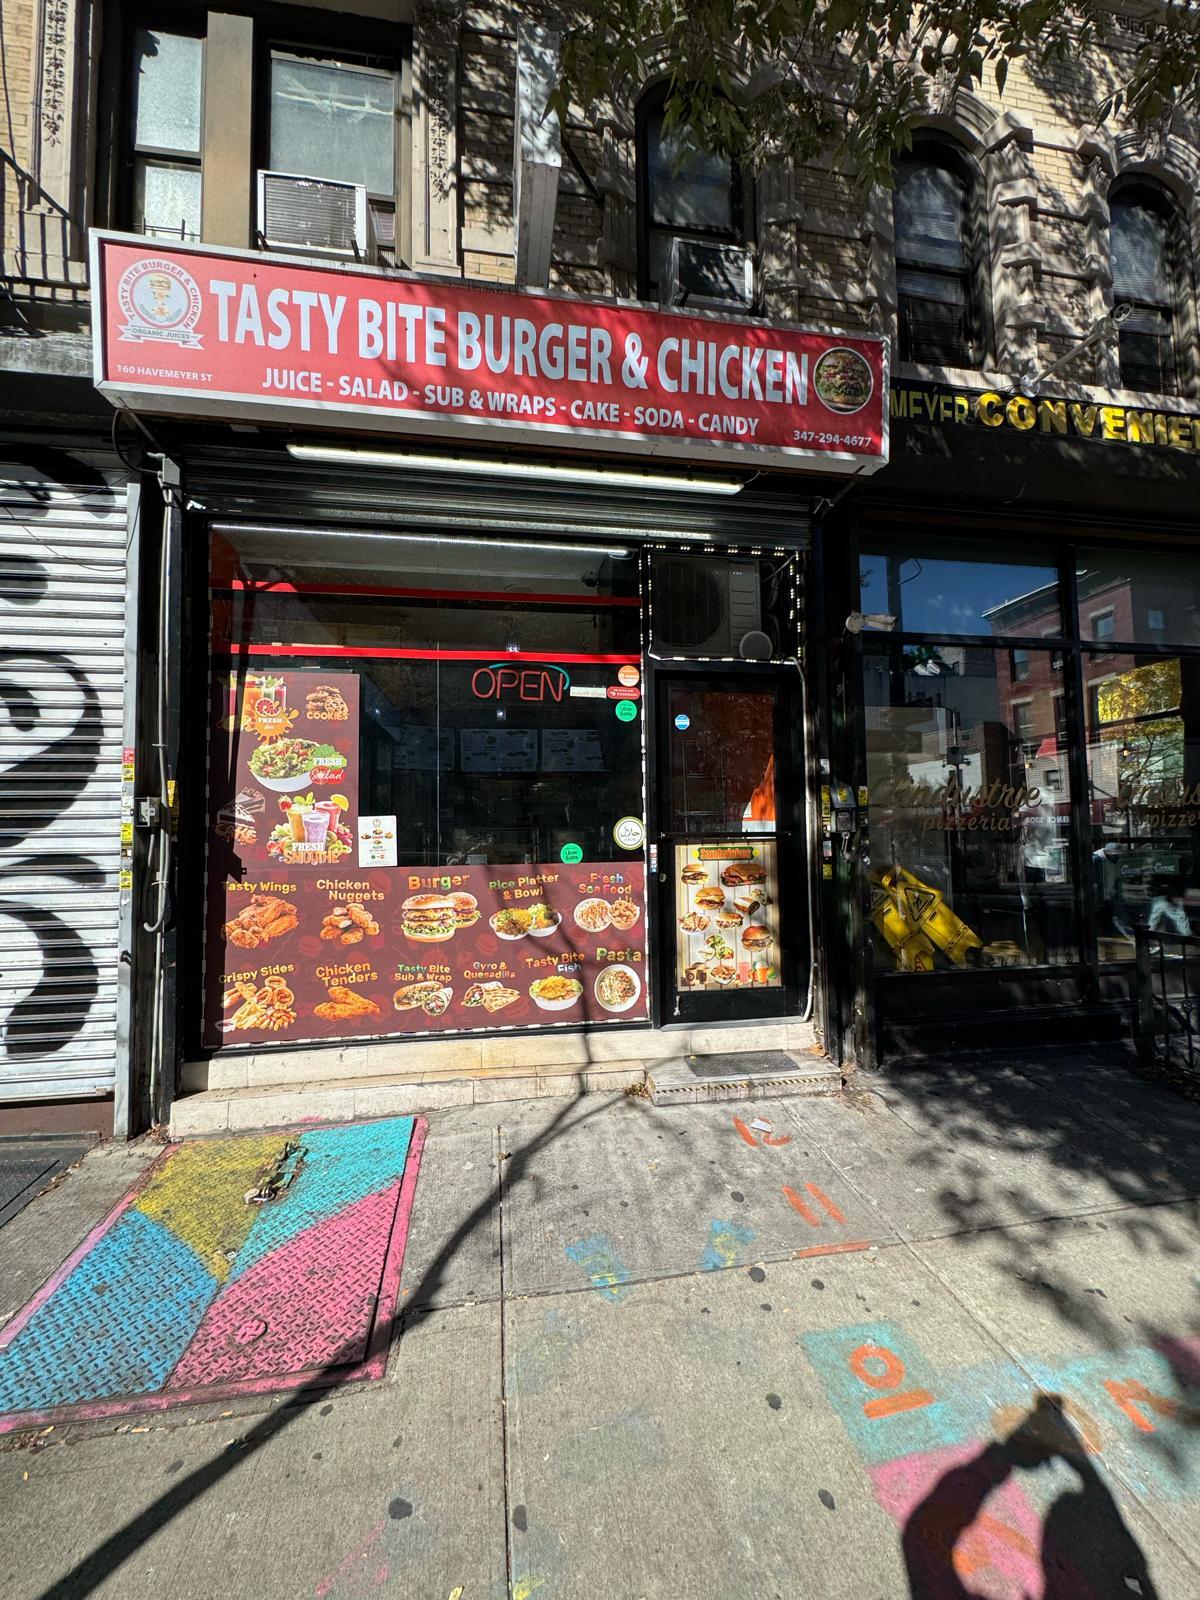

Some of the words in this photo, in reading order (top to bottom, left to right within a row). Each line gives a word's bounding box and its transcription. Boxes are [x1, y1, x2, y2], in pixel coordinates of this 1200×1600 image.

[123, 266, 142, 286] BITE
[140, 262, 184, 278] BURGER
[121, 287, 136, 320] TASTY
[183, 287, 200, 329] CHICKEN
[131, 327, 164, 337] ORGANIC
[165, 332, 190, 340] JUICES
[210, 280, 347, 354] TASTY
[359, 299, 446, 367] BITE
[458, 311, 613, 386] BURGER
[622, 332, 648, 390] &
[657, 337, 808, 406] CHICKEN
[117, 364, 135, 375] 160
[137, 366, 199, 381] HAVEMEYER
[200, 373, 212, 382] ST
[262, 367, 322, 393] JUICE
[339, 375, 408, 402] SALAD
[424, 384, 464, 408] SUB
[468, 391, 484, 410] &
[487, 391, 556, 417] WRAPS
[570, 399, 619, 423] CAKE
[634, 406, 684, 429] SODA
[698, 413, 759, 436] CANDY
[793, 430, 872, 448] 347-294-4677
[471, 667, 564, 703] OPEN
[306, 711, 348, 721] COOKIES
[313, 757, 342, 766] FRESH
[311, 767, 345, 781] Salad
[292, 842, 325, 851] FRESH
[316, 879, 370, 890] Chicken
[408, 873, 470, 892] Burger
[488, 879, 516, 891] Rice
[518, 873, 560, 887] Platter
[590, 872, 624, 884] Fresh
[260, 881, 297, 894] Wings
[503, 890, 512, 900] &
[514, 886, 544, 899] Bowl
[578, 884, 601, 894] Sea
[603, 884, 632, 894] Food
[328, 890, 385, 904] Nuggets
[525, 955, 559, 969] Tasty
[561, 952, 585, 963] Bite
[596, 947, 642, 963] Pasta
[219, 970, 258, 985] Crispy
[260, 963, 295, 977] Sides
[315, 961, 371, 977] Chicken
[398, 964, 427, 974] Tasty
[428, 964, 451, 973] Bite
[473, 961, 498, 972] Gyro
[499, 961, 507, 970] &
[557, 963, 582, 973] Fish
[321, 970, 379, 988] Tenders
[394, 973, 415, 982] Sub
[416, 973, 425, 981] &
[426, 973, 452, 983] Wrap
[463, 970, 516, 980] Quesadilla
